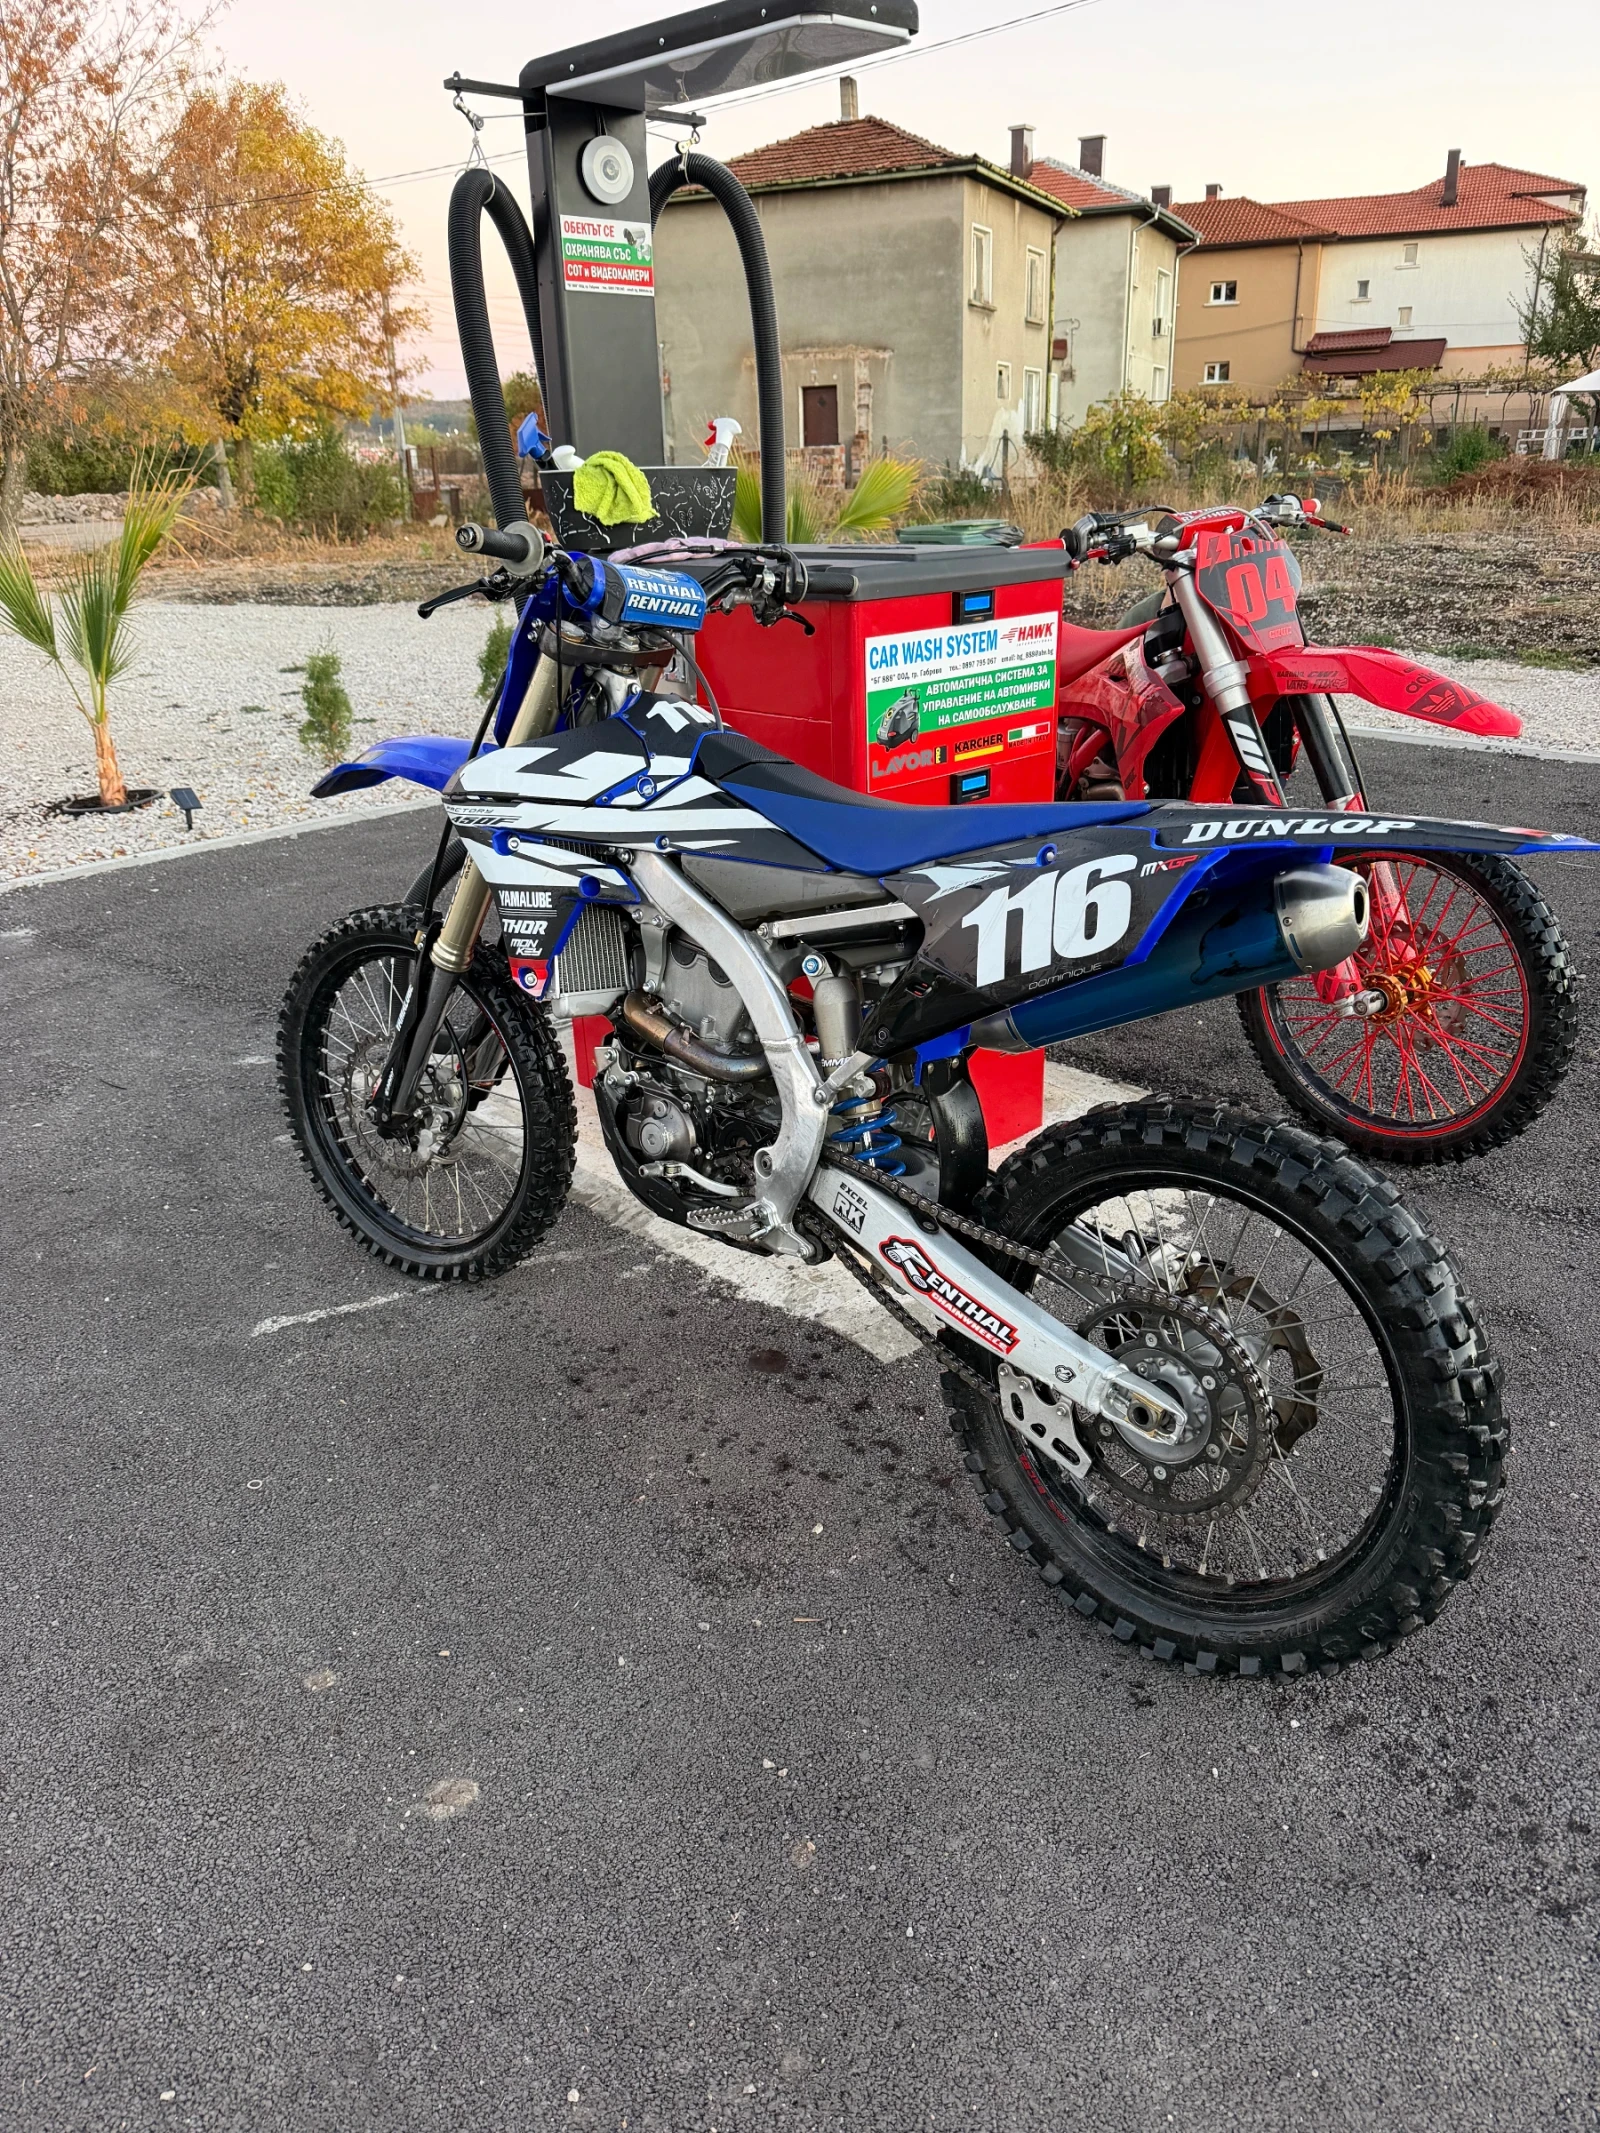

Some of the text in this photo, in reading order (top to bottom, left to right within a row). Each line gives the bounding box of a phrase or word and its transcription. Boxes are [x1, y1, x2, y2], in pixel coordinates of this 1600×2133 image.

[563, 220, 615, 238] ОБЕКТЪТ СЕ
[565, 242, 632, 261] ОХРАНЯВА СЪС
[567, 263, 650, 283] СОТ и ВИДЕОКАМЕРИ
[626, 577, 700, 600] RENTHAL
[1225, 556, 1296, 626] 04
[627, 593, 700, 617] RENTHAL
[1017, 622, 1055, 642] HAWK
[869, 629, 998, 670] CAR WASH SYSTEM
[920, 668, 942, 677] Габрово
[962, 661, 974, 669] 0897
[986, 657, 997, 666] 067
[925, 664, 1048, 697] АВТОМАТИЧНА СИСТЕМА ЗА
[1286, 680, 1308, 690] VANS
[922, 679, 1051, 713] УПРАВЛЕНИЕ НА АВТОМИВКИ
[938, 696, 1037, 726] НА САМООБСЛУЖВАНЕ
[954, 733, 1004, 753] KÄRCHER
[1008, 739, 1024, 748] MADE
[1033, 734, 1049, 743] ITALY
[872, 749, 934, 778] LAVOR
[452, 815, 520, 826] 450F
[1182, 818, 1418, 844] DUNLOP
[1140, 854, 1199, 878] MXGP
[498, 890, 553, 908] YAMALUBE
[501, 918, 548, 935] THOR
[961, 854, 1138, 988] 116
[516, 947, 543, 957] KEY
[1028, 962, 1102, 990] DOMINIQUE
[839, 1182, 868, 1210] EXCEL
[834, 1197, 864, 1228] RK
[885, 1241, 1013, 1345] RENTHAL
[931, 1292, 1009, 1352] CHAINWHEELS
